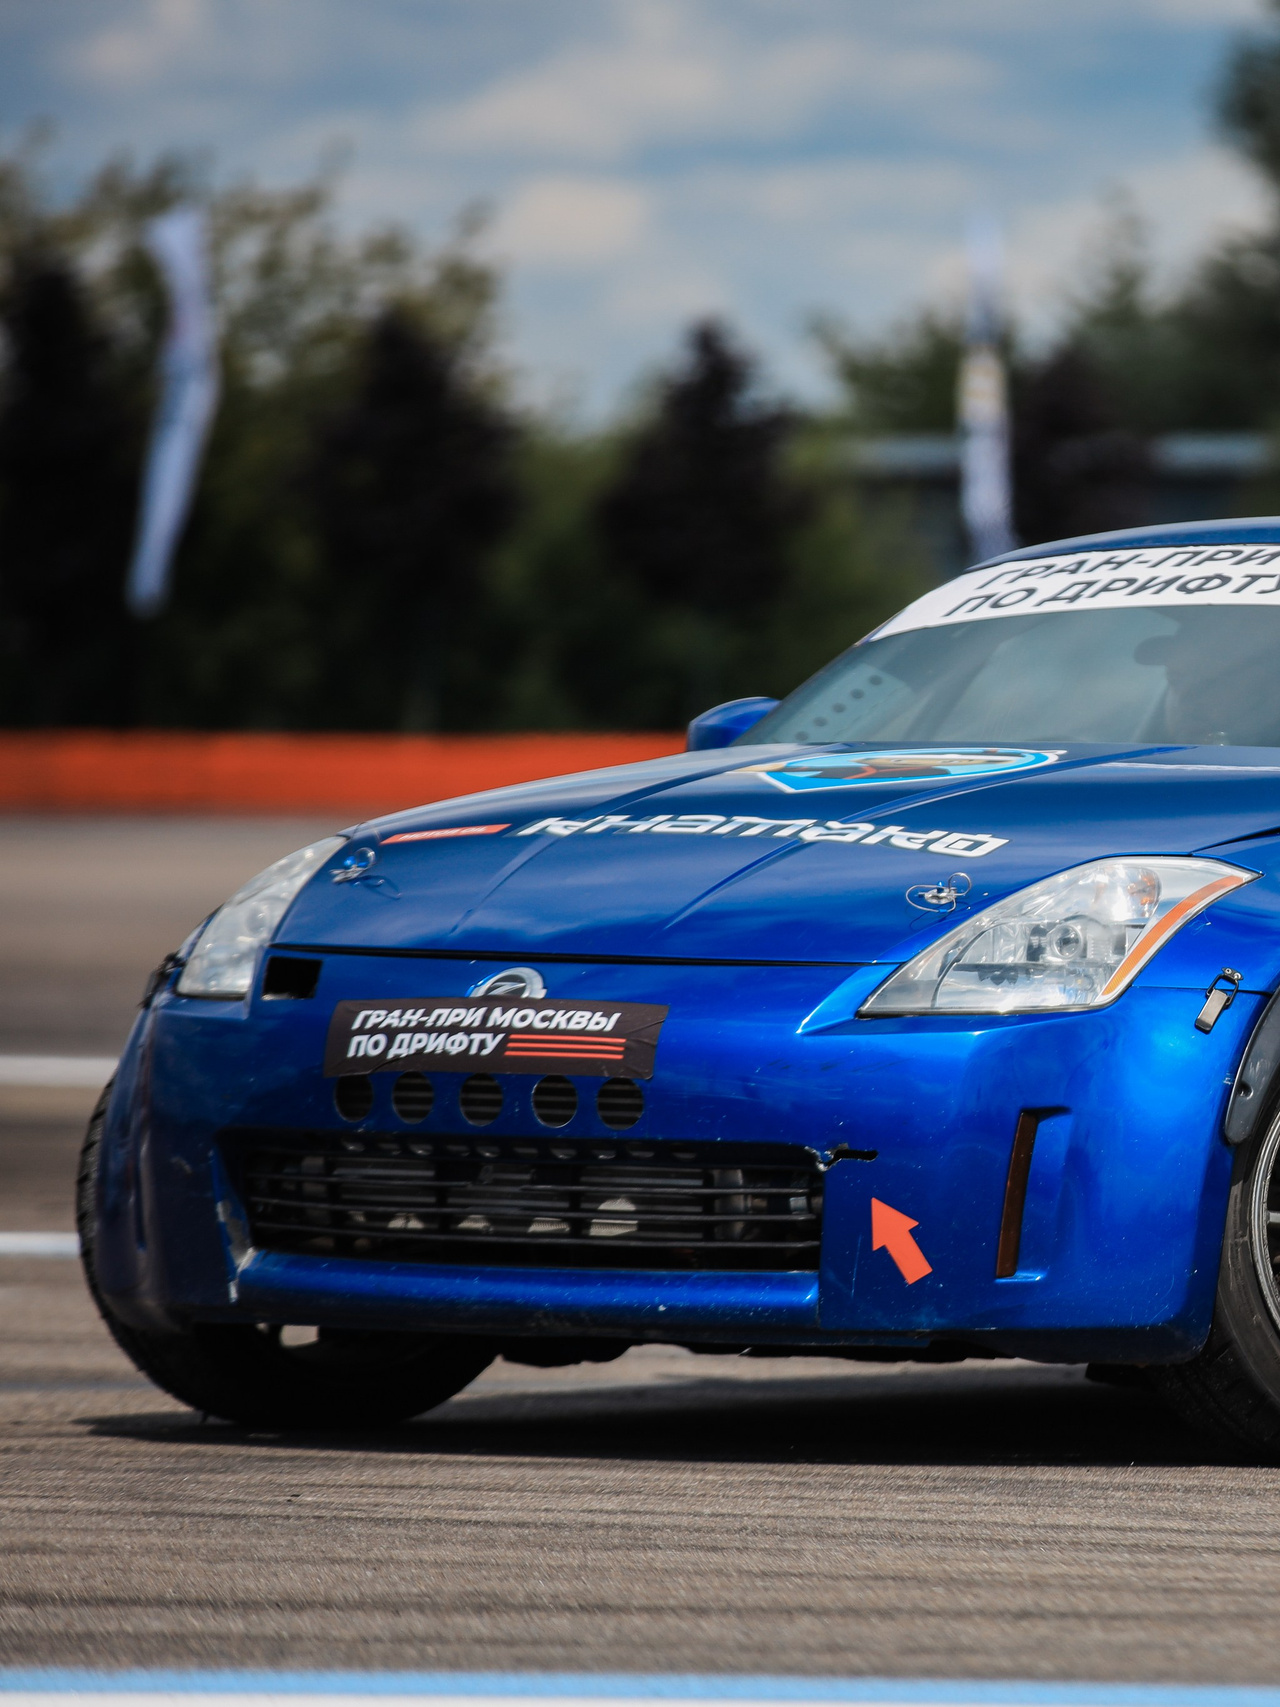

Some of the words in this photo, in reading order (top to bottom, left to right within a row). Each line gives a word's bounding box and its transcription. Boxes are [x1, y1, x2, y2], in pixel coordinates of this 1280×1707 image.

[942, 586, 1037, 617] ПО
[350, 1005, 490, 1032] ГРАН-ПРИ
[487, 1006, 622, 1033] МОСКВЫ
[346, 1034, 388, 1058] ПО
[386, 1032, 506, 1059] ДРИФТУ
